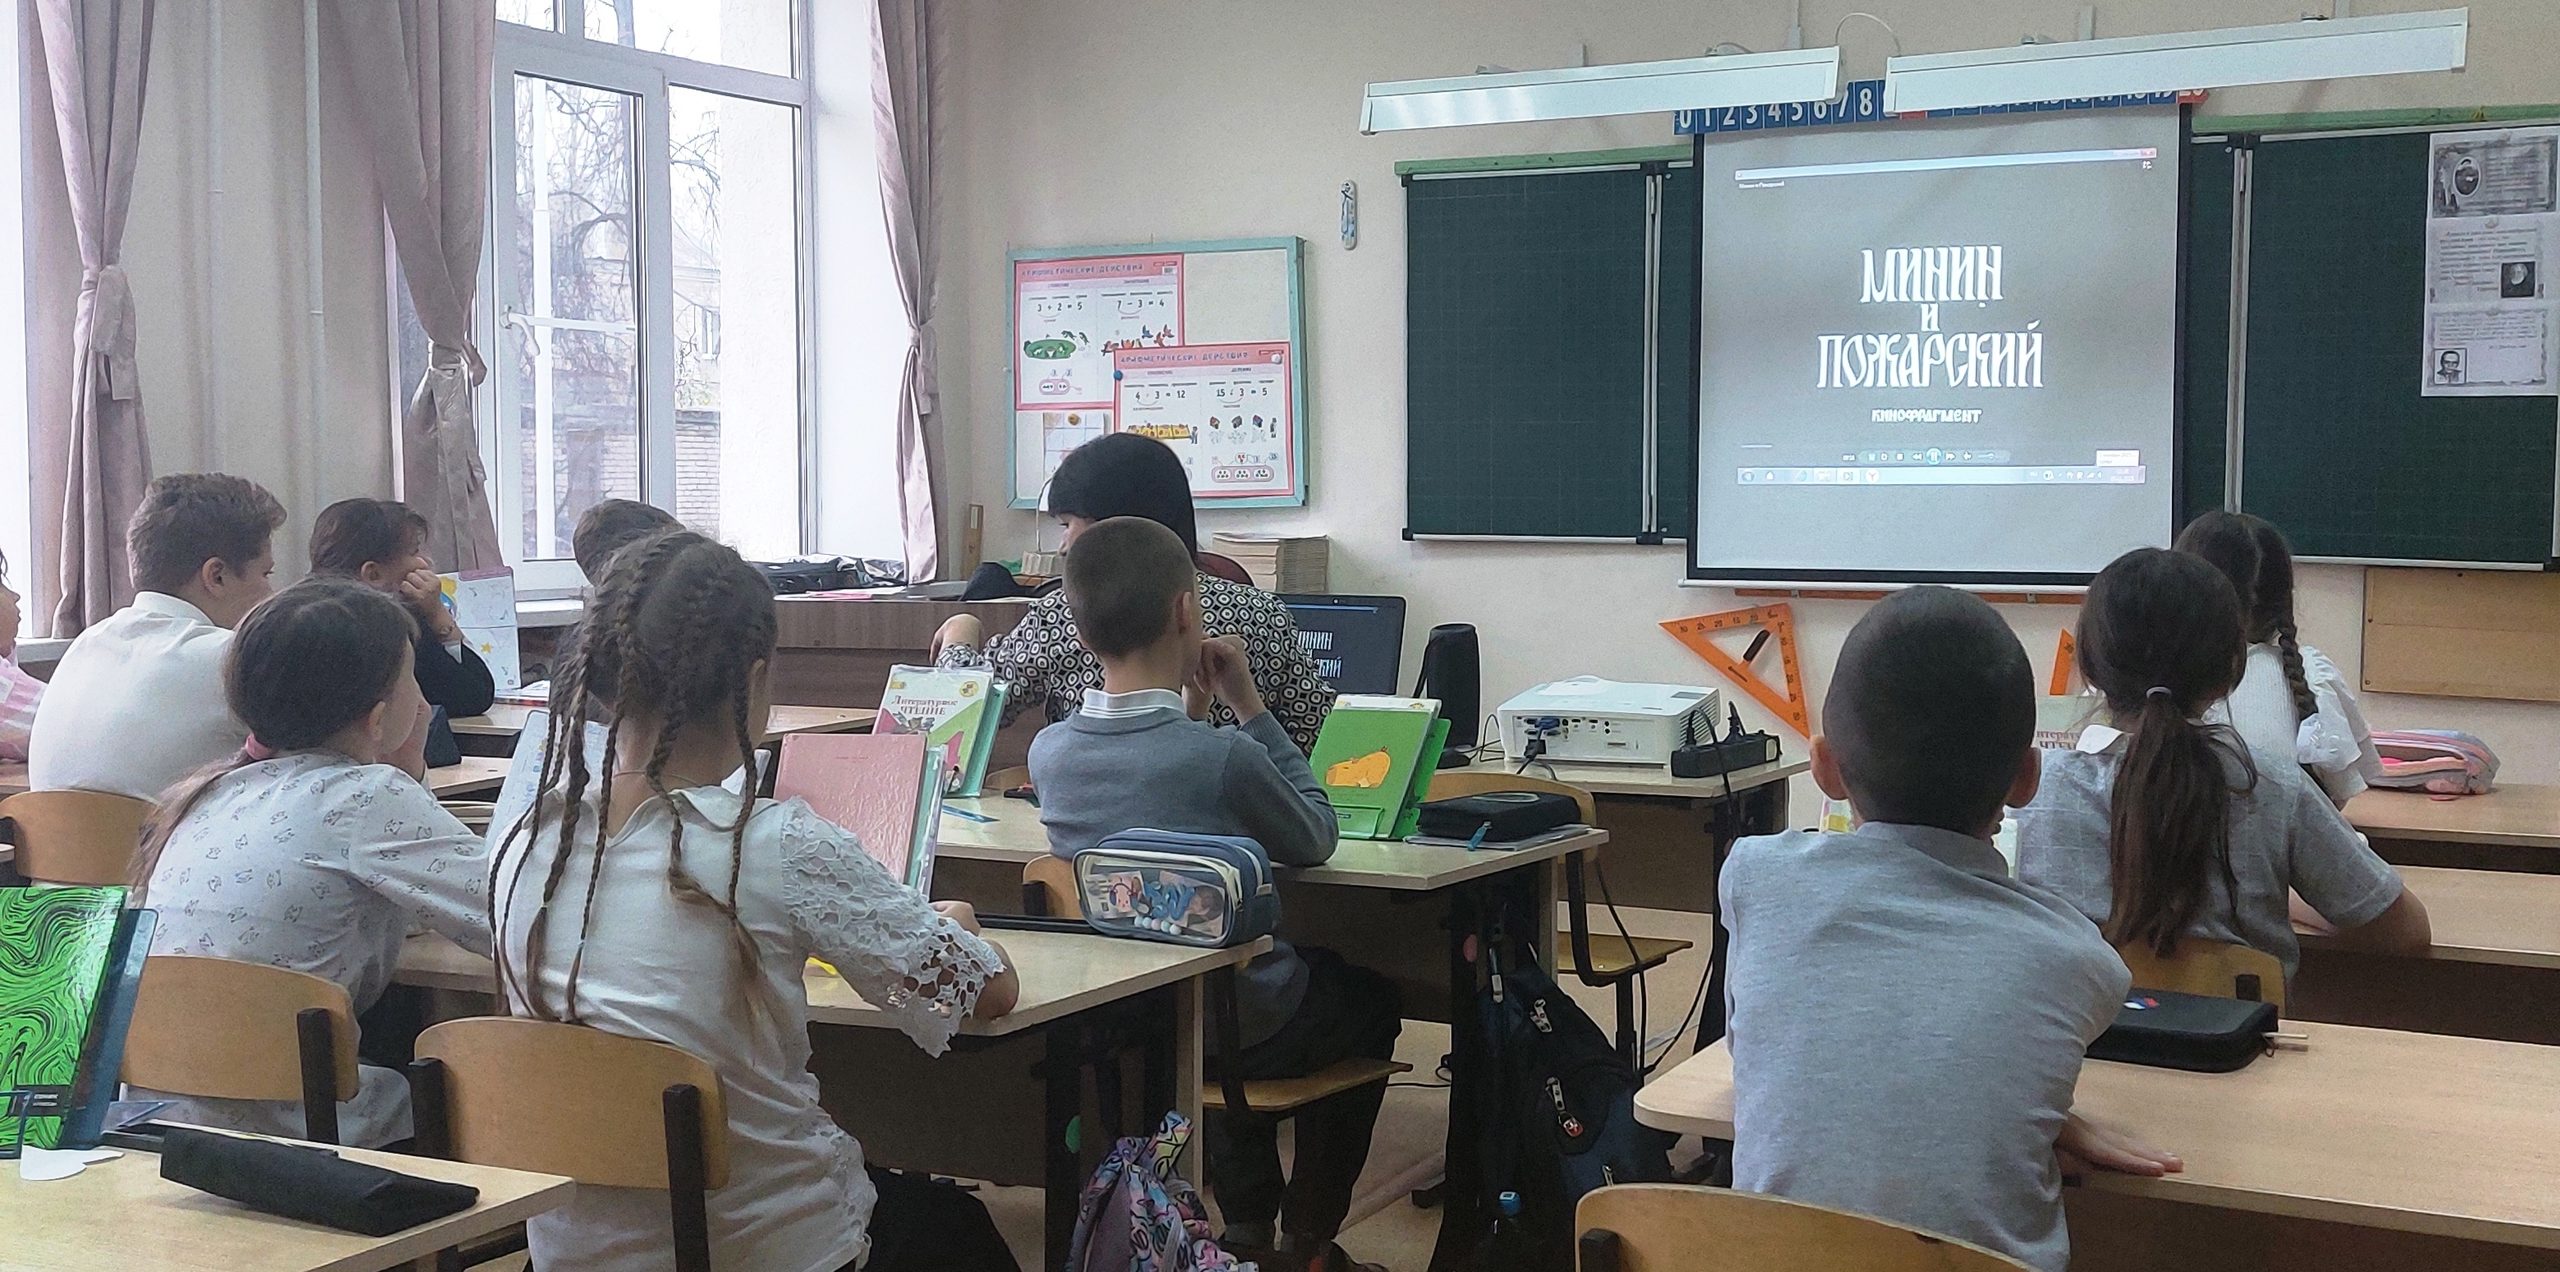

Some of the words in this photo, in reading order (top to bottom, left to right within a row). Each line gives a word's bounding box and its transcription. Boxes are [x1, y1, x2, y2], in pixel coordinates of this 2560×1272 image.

[1679, 109, 1692, 129] 0
[1723, 107, 1736, 126] 2
[1746, 105, 1758, 124] 3
[1768, 104, 1782, 122] 4
[1791, 103, 1803, 121] 5
[1814, 101, 1828, 119] 6
[1859, 88, 1873, 116] 8
[1859, 245, 2004, 303] МИНИН
[1816, 319, 2044, 388] ПОЖАРСКИЙ
[1871, 408, 1983, 423] КИНОФРАГМЕНТ
[900, 705, 946, 715] ЧТЕНИЕ
